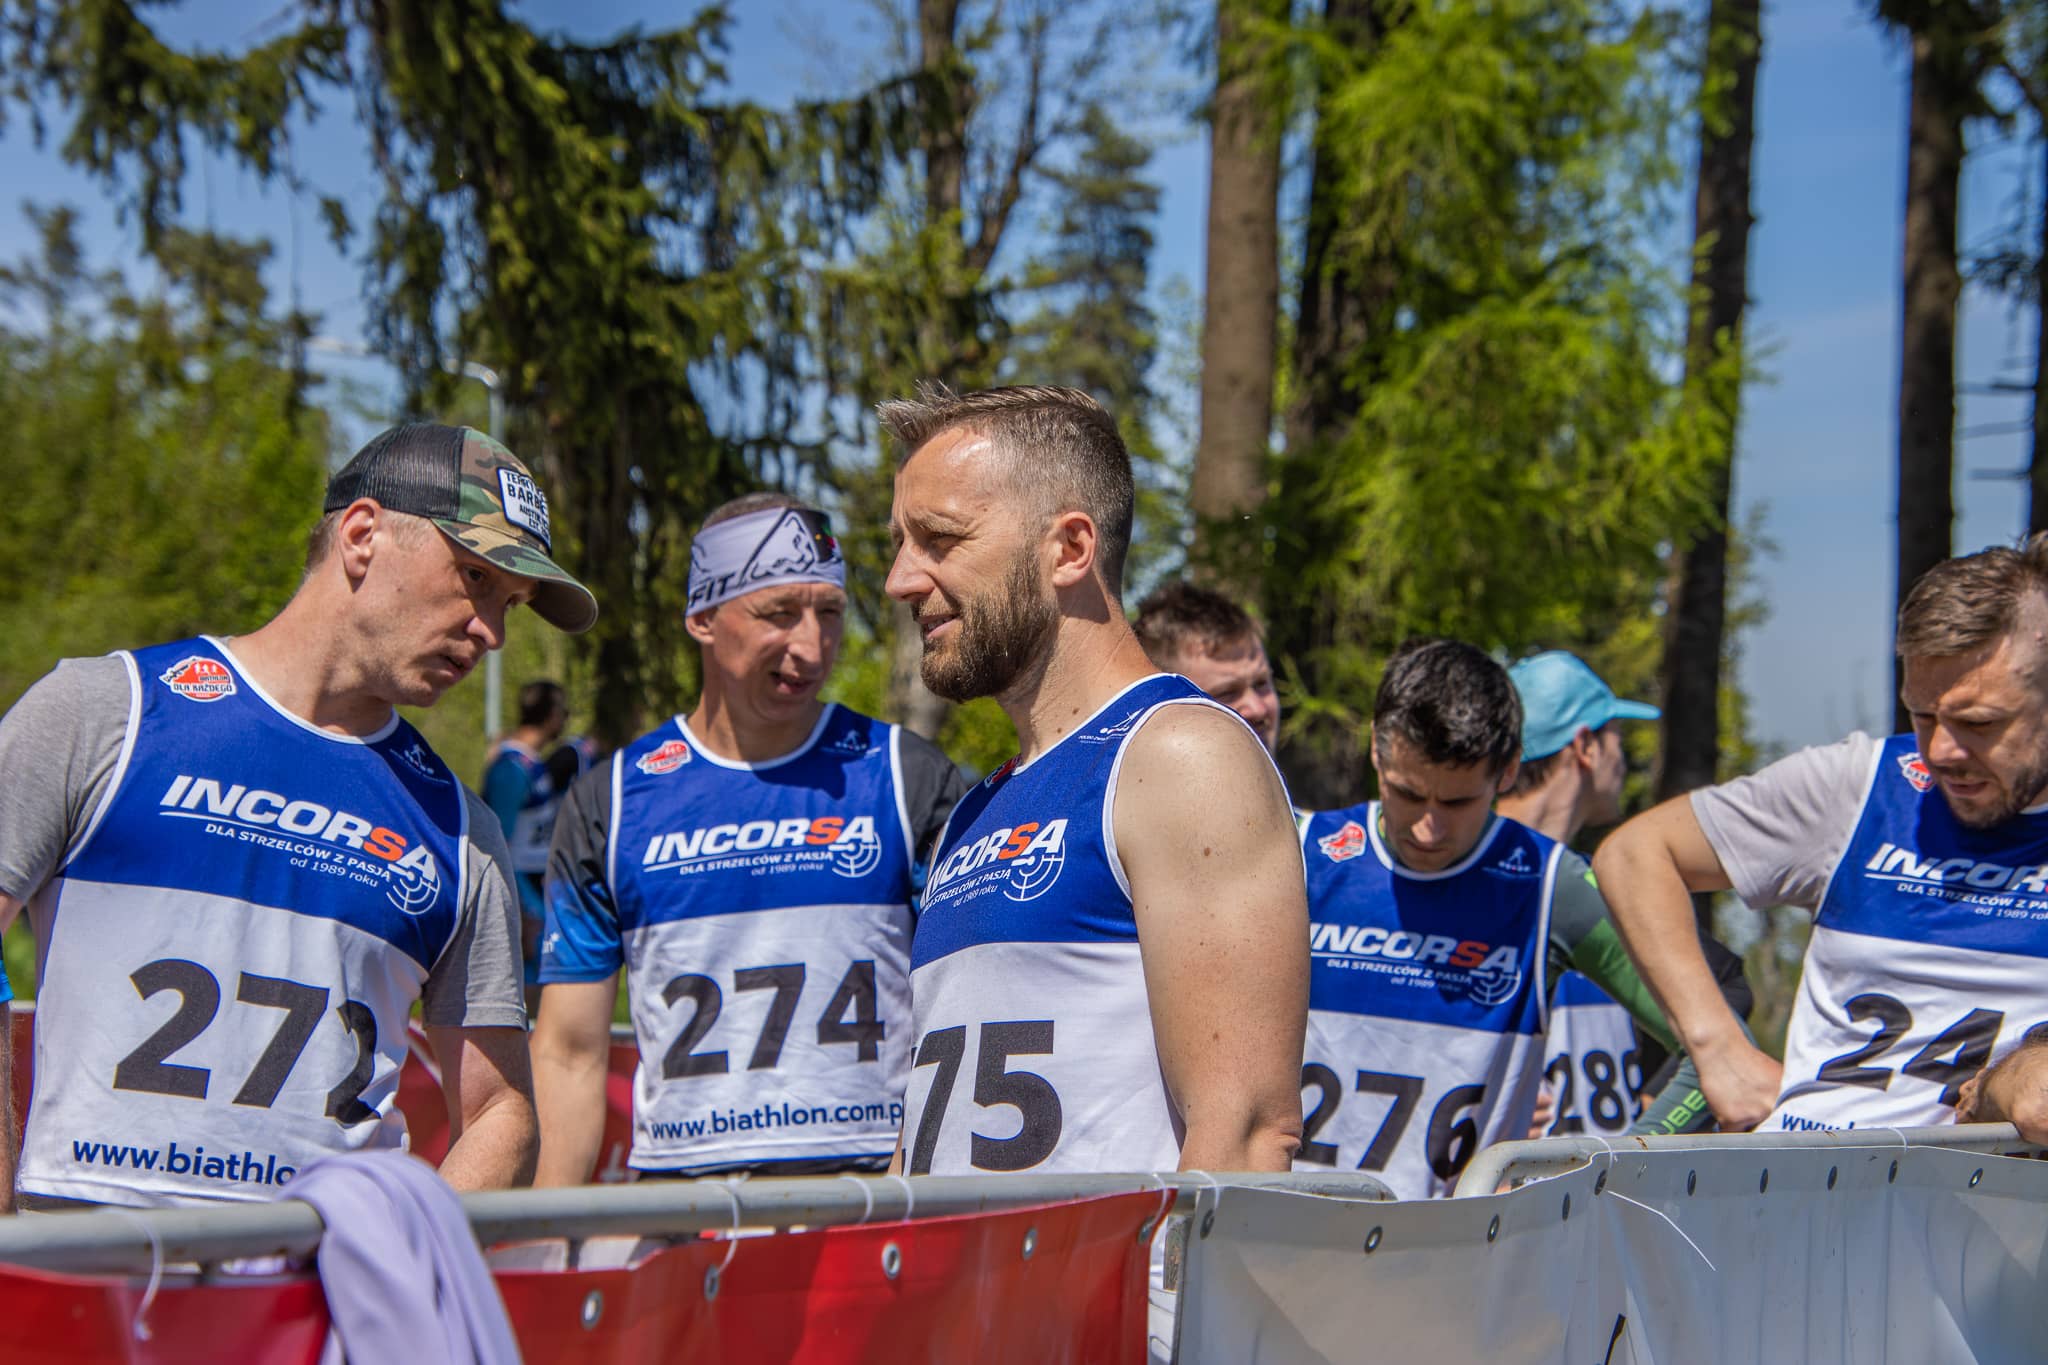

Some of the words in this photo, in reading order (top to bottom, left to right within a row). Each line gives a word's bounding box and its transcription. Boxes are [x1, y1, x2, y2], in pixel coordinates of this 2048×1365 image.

[159, 774, 438, 883] INCORSA
[205, 823, 235, 838] DLA
[238, 831, 332, 860] STRZELCÓW
[333, 853, 345, 864] Z
[642, 816, 875, 866] INCORSA
[290, 857, 308, 868] od
[311, 861, 347, 877] 1989
[349, 870, 379, 888] roku
[680, 861, 706, 876] DLA
[707, 854, 782, 871] STRZELCÓW
[783, 852, 793, 863] Z
[769, 863, 797, 875] 1989
[1865, 843, 2048, 895] INCOR
[1897, 882, 1924, 895] DLA
[1926, 886, 2014, 907] STRZELCÓW
[2015, 898, 2027, 909] Z
[1974, 906, 1993, 916] od
[1996, 908, 2029, 919] 1989
[112, 958, 384, 1126] 272
[661, 959, 885, 1081] 274
[1816, 993, 2048, 1106] 24
[902, 1020, 1062, 1173] 75
[1294, 1062, 1488, 1183] 276
